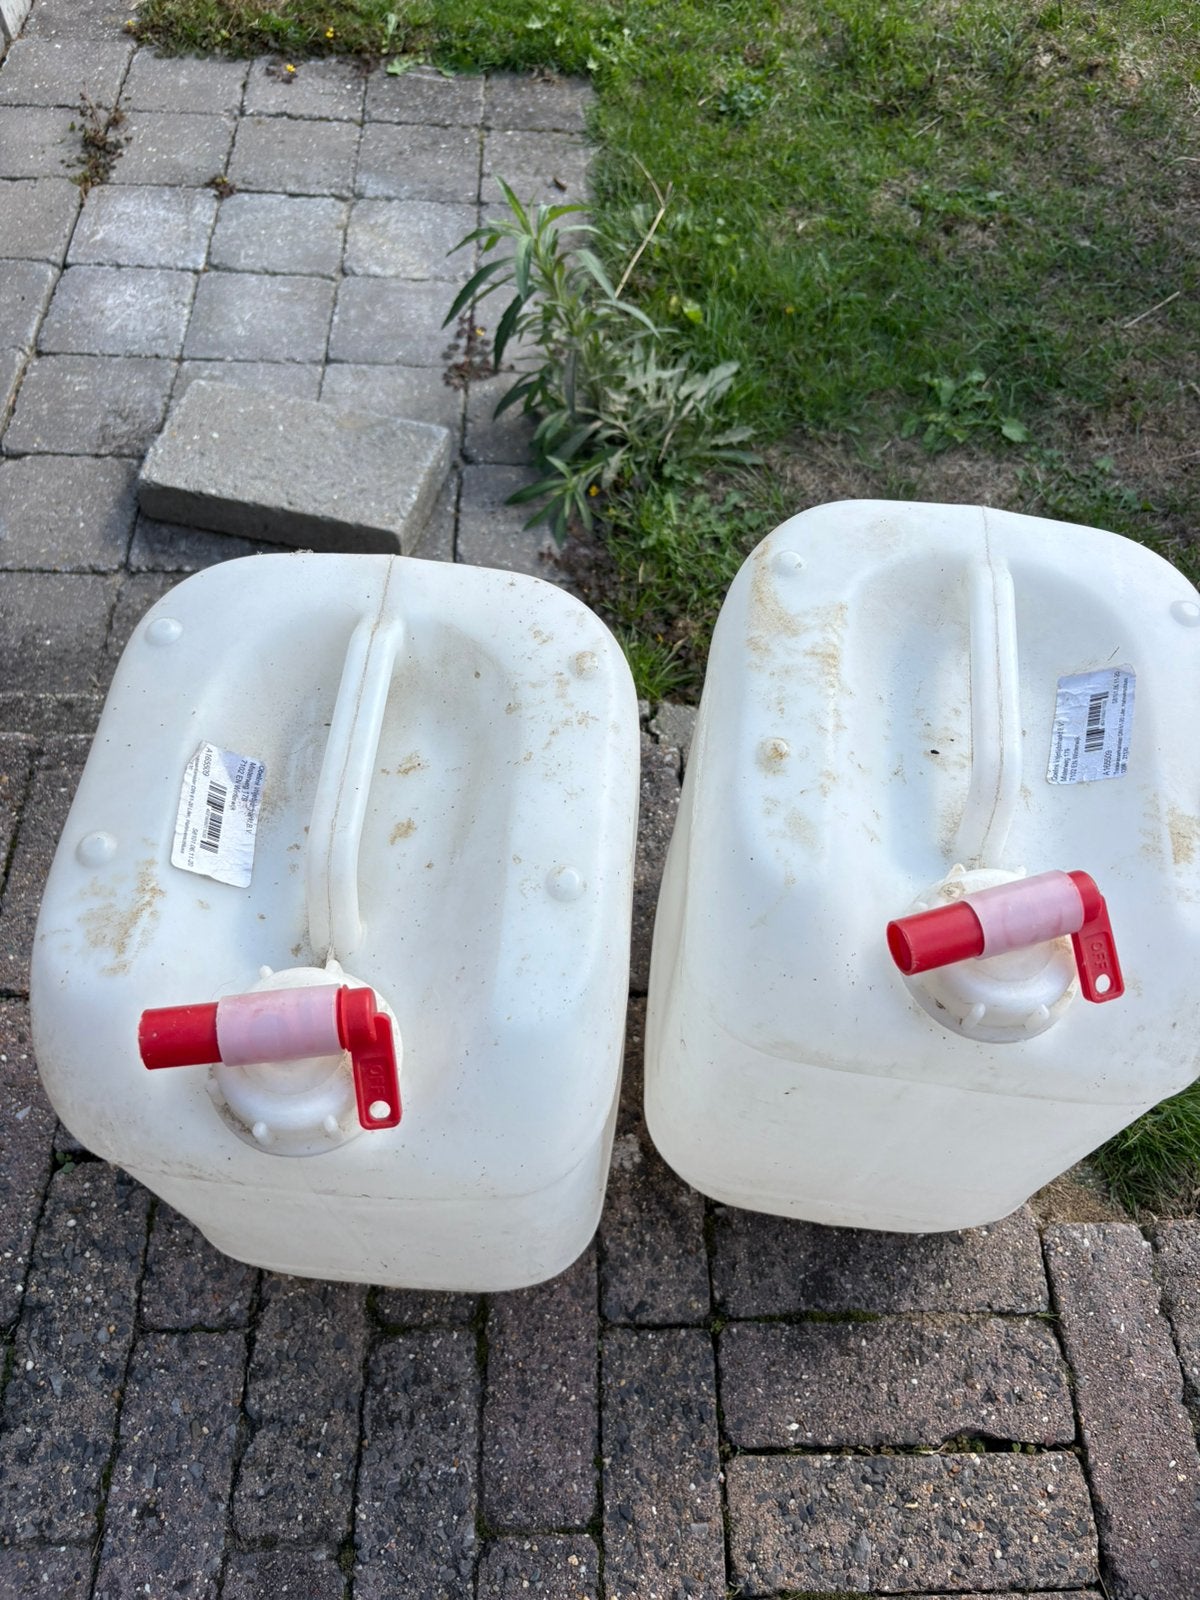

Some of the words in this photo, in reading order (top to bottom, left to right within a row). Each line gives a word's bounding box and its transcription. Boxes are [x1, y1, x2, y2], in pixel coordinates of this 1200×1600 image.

[202, 746, 213, 776] A165509
[237, 759, 247, 774] 7102
[235, 774, 242, 783] EN
[1091, 942, 1108, 969] OFF
[369, 1063, 386, 1094] OFF
